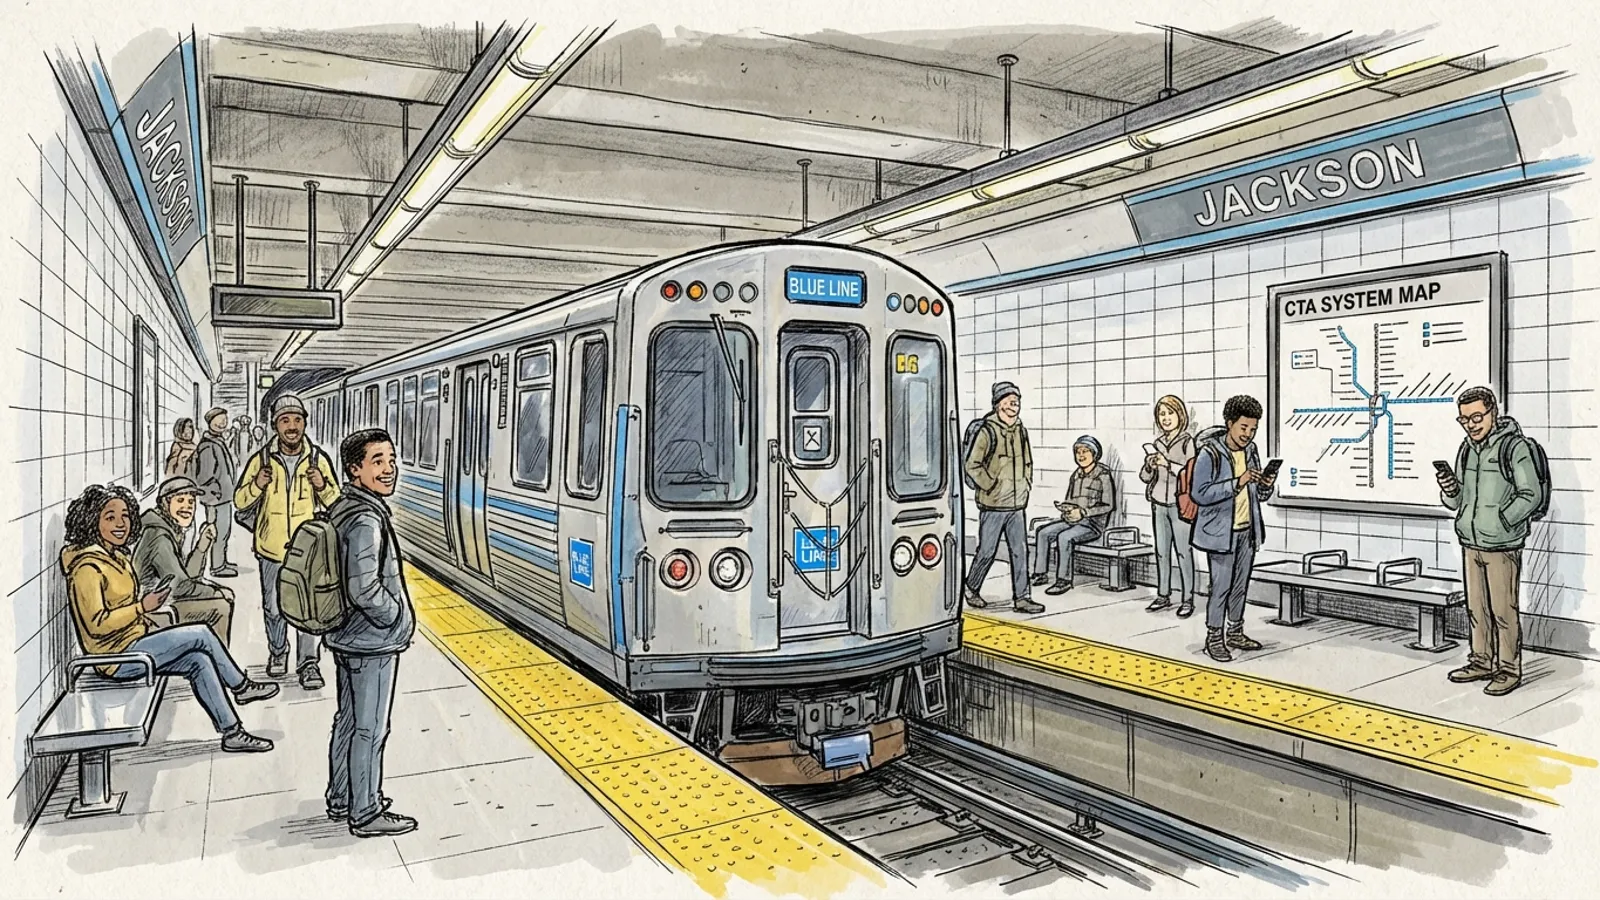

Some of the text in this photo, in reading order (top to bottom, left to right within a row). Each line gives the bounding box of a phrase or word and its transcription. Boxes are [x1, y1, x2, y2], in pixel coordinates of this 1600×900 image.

[136, 97, 195, 246] JACKSON
[1194, 137, 1426, 227] JACKSON
[789, 277, 859, 298] BLUE LINE
[1284, 281, 1442, 317] CTA SYSTEM MAP
